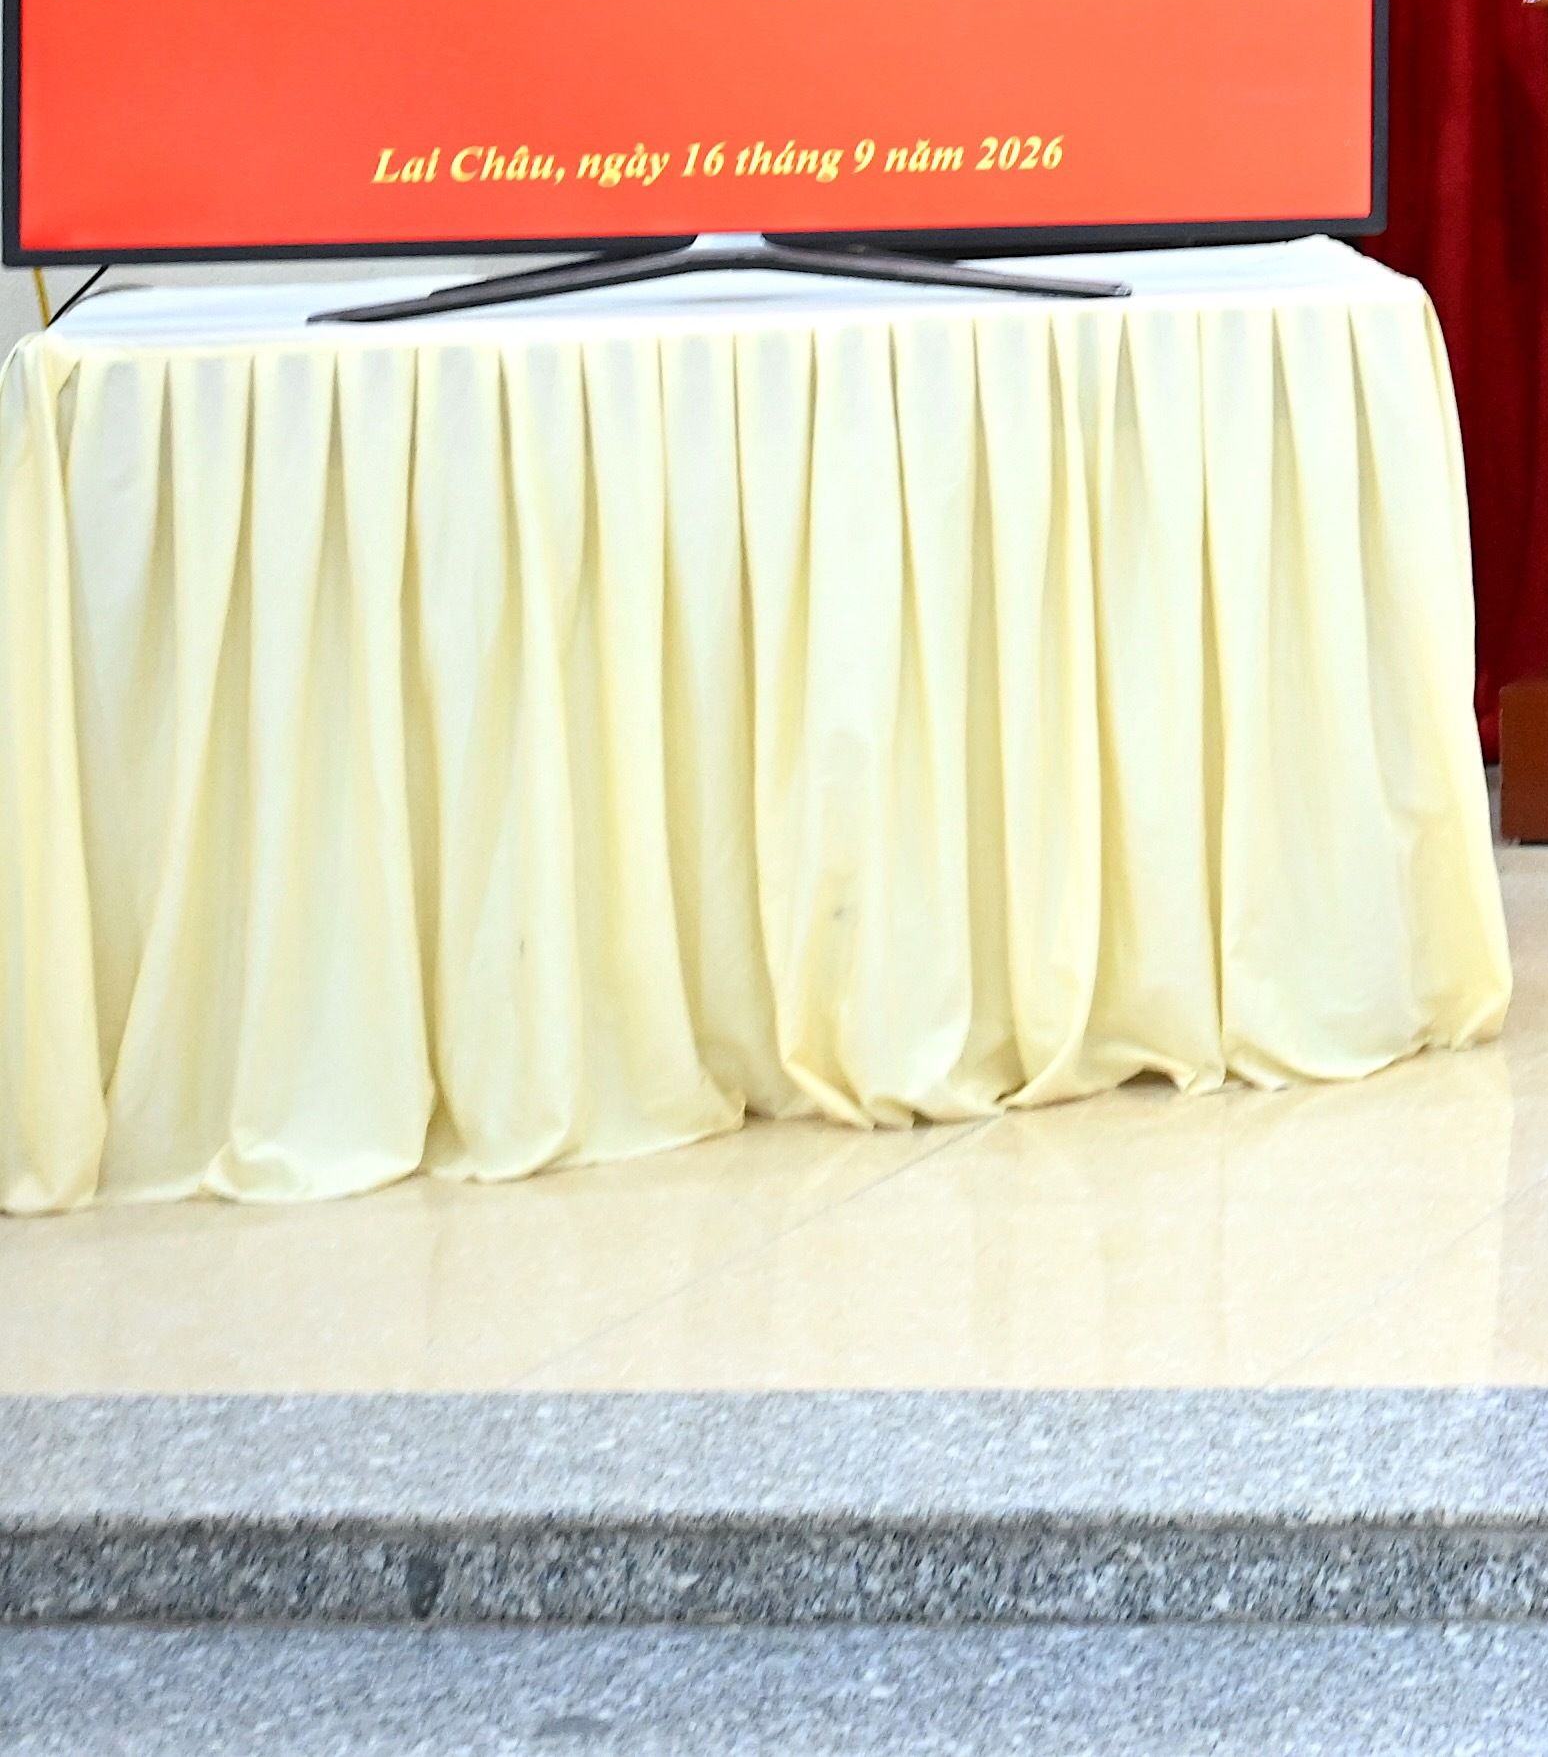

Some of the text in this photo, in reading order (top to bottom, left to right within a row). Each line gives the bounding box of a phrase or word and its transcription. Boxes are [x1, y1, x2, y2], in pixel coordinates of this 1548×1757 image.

[371, 134, 1065, 188] Lai Châu, ngày 16 tháng 9 năm 2026
